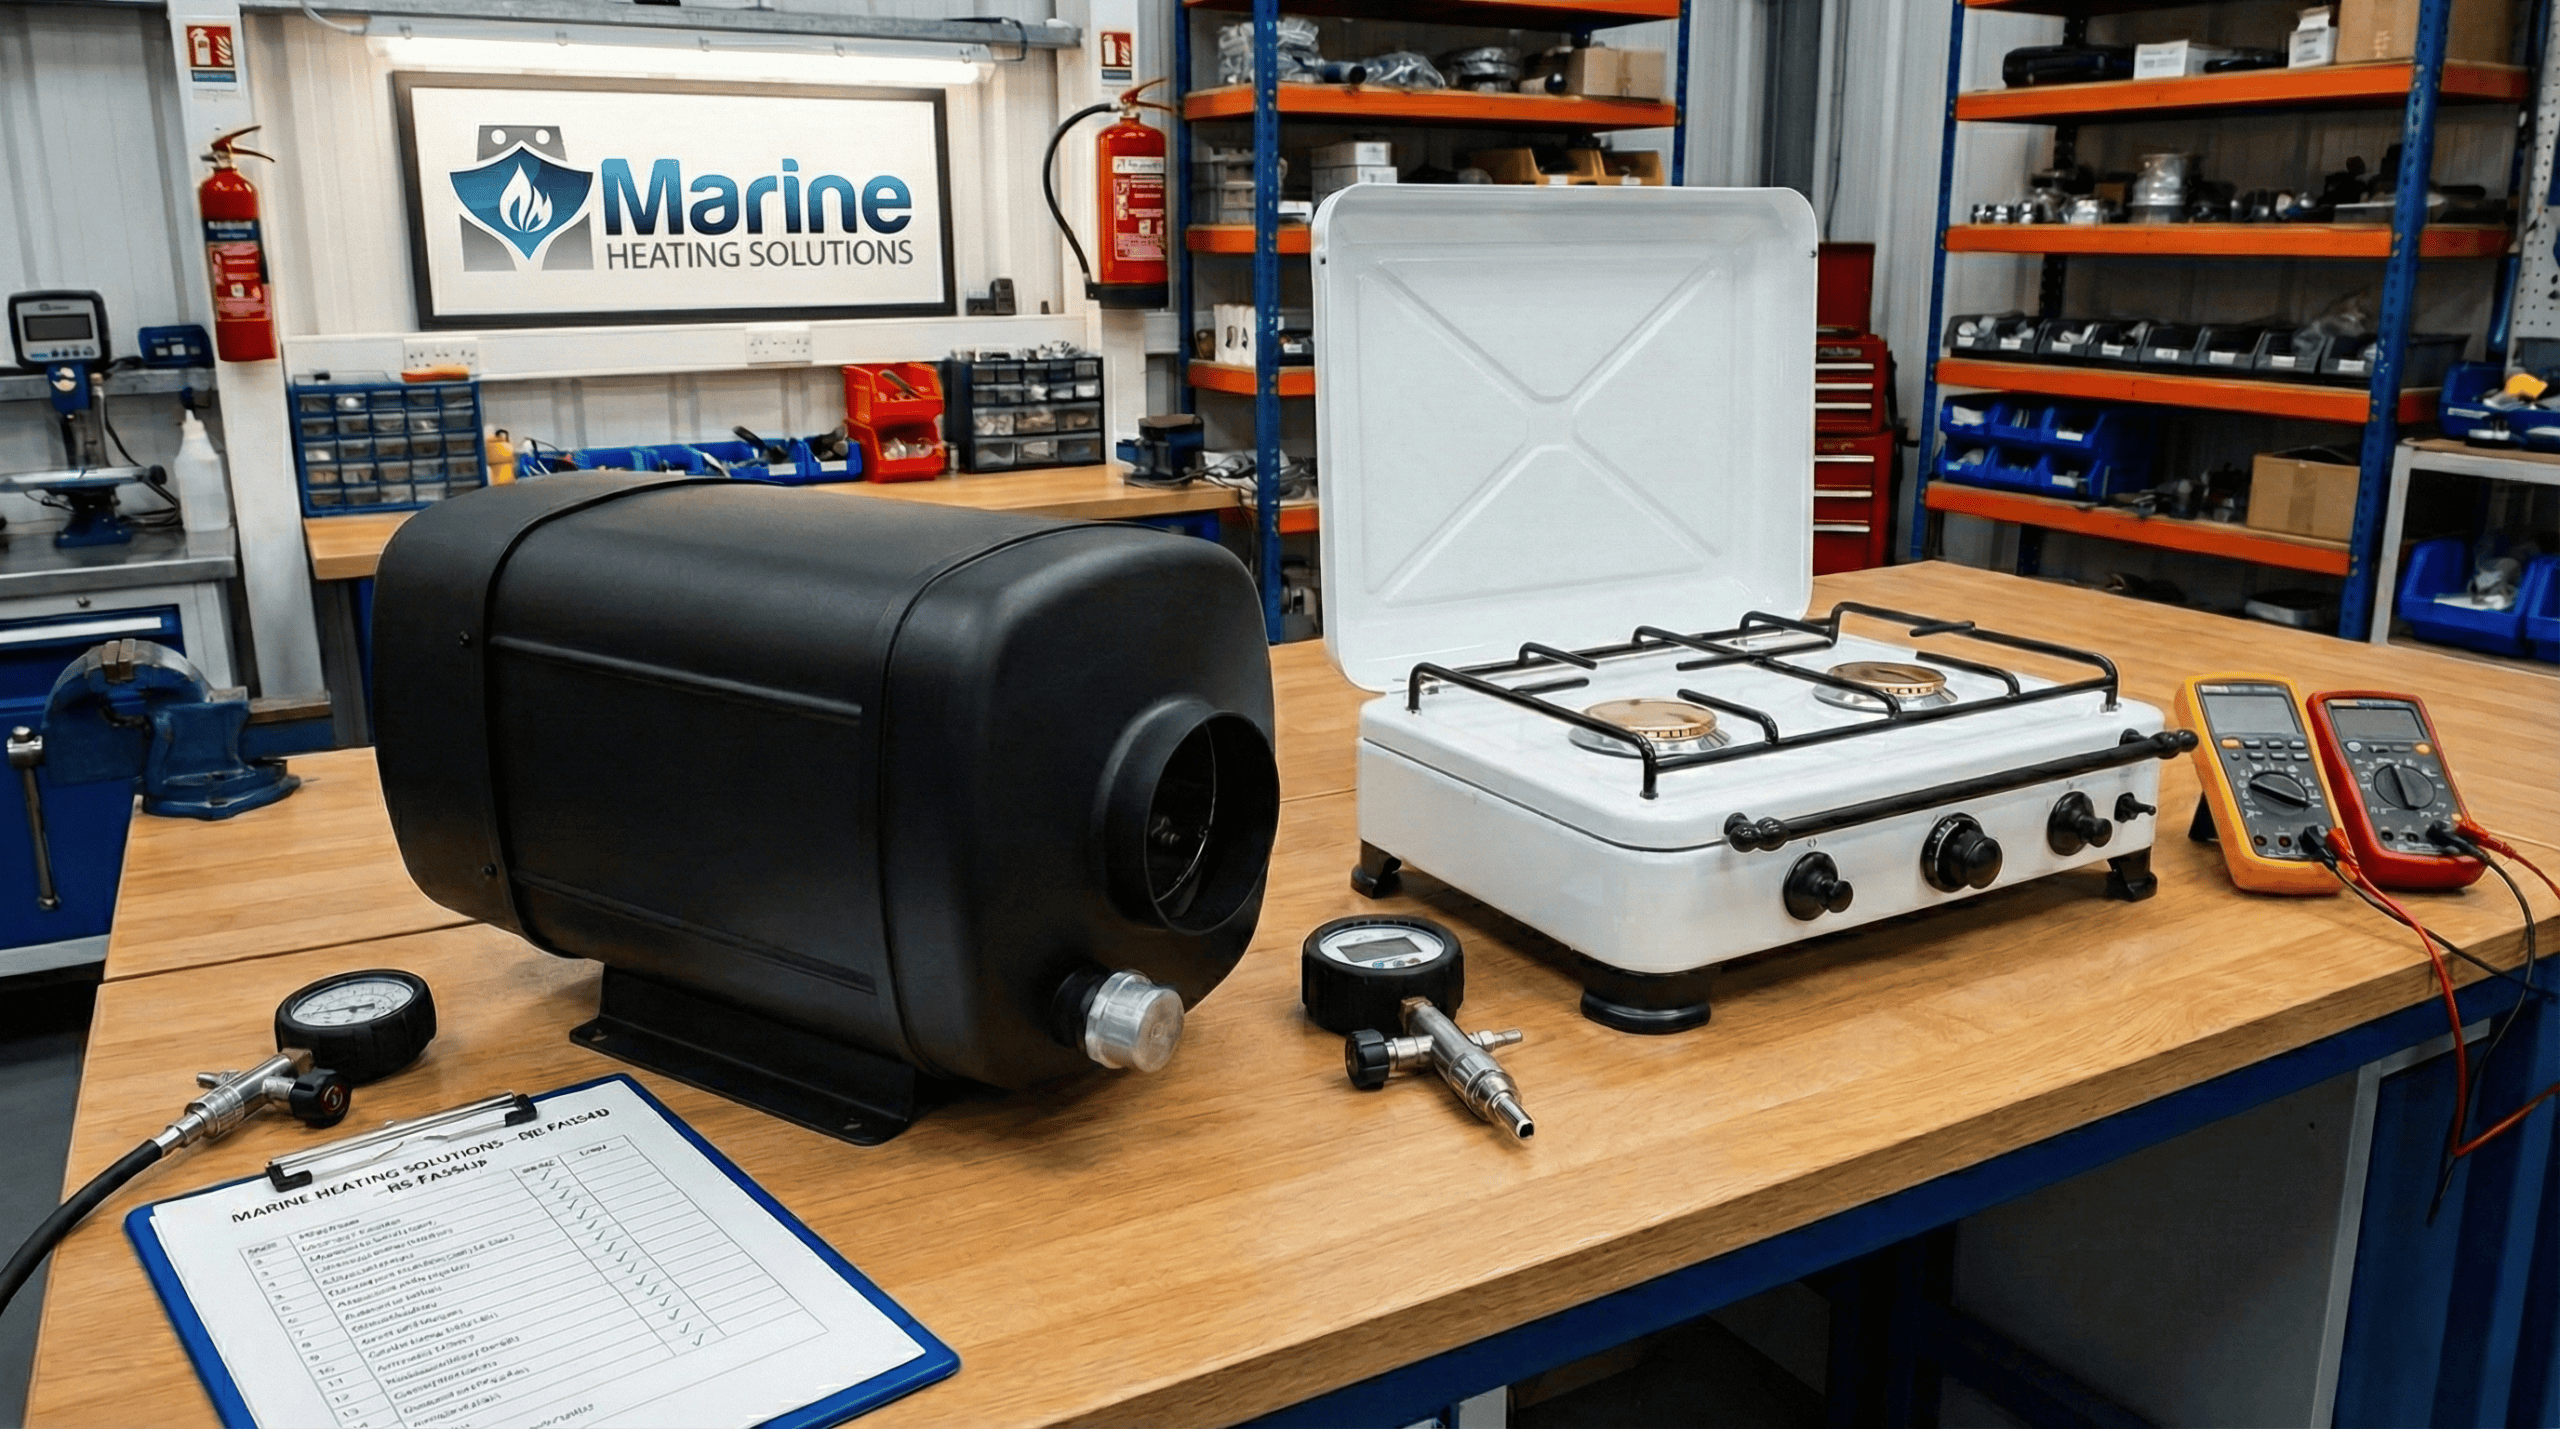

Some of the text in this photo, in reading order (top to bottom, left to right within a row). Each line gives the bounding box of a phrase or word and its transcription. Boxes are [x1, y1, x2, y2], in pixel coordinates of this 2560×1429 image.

[601, 158, 912, 235] Marine
[606, 239, 914, 270] HEATING SOLUTIONS
[231, 1193, 310, 1223] MARINE
[315, 1168, 400, 1200] HEATING
[402, 1140, 504, 1173] SOLUTIONS
